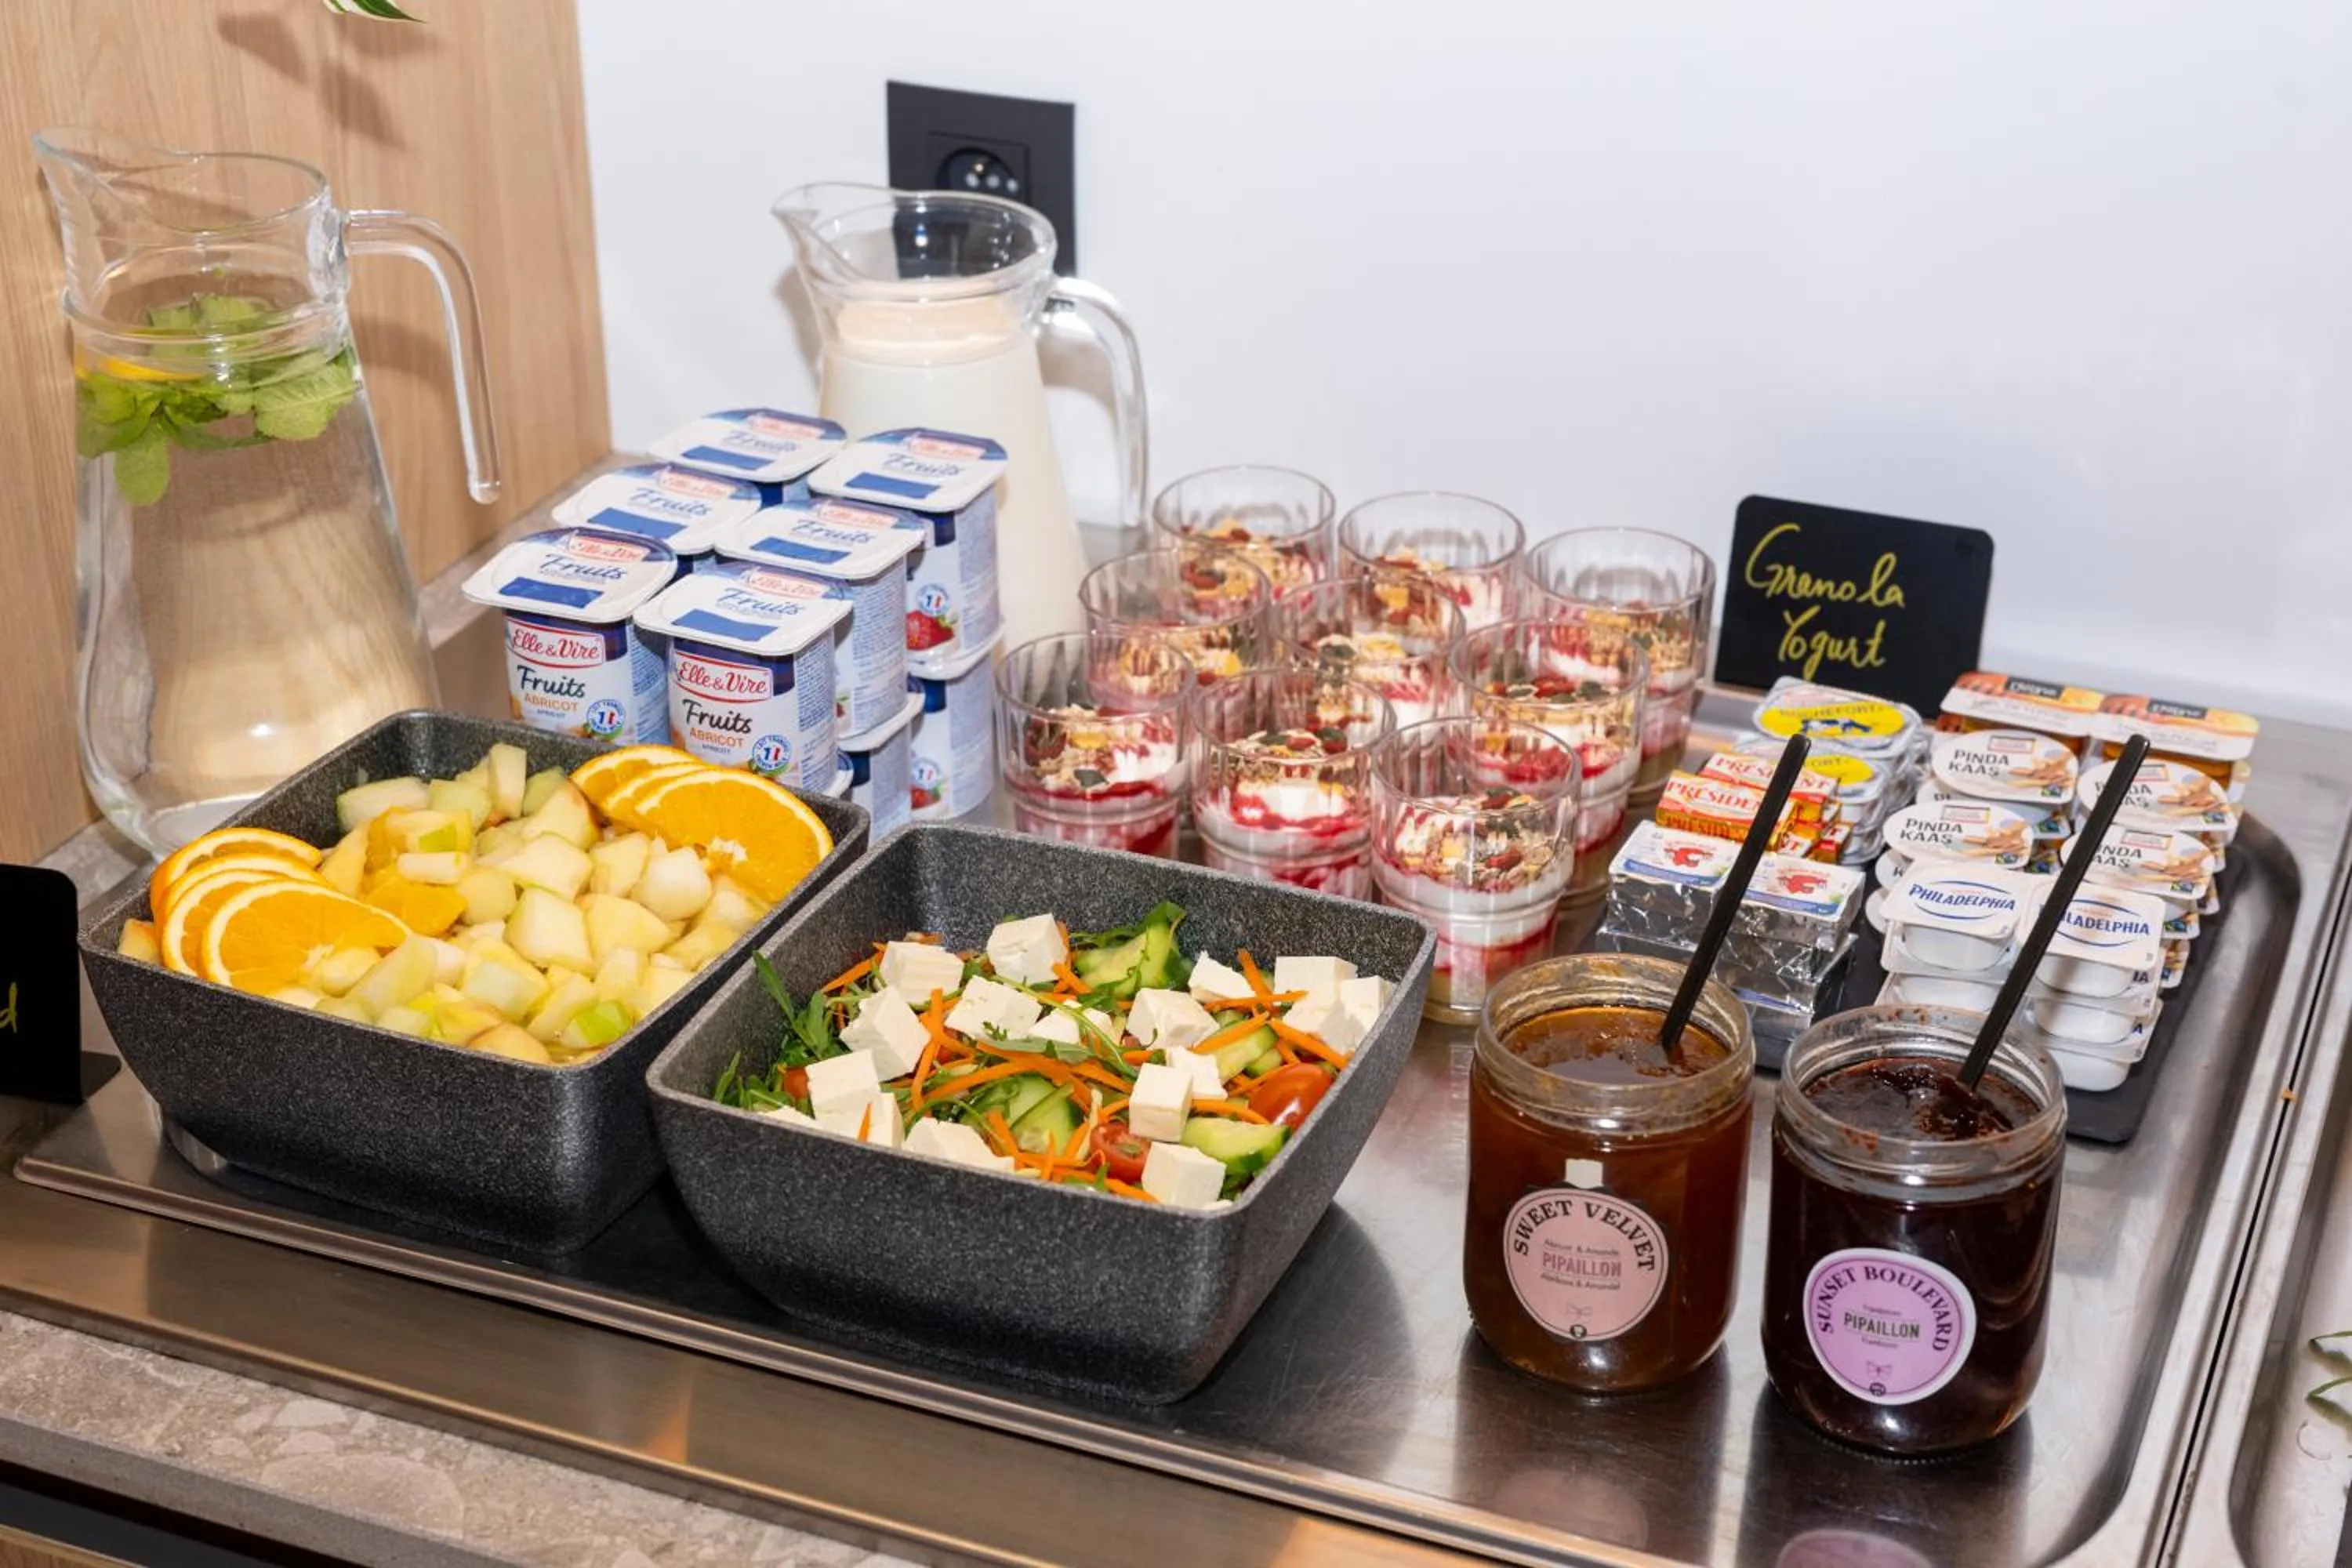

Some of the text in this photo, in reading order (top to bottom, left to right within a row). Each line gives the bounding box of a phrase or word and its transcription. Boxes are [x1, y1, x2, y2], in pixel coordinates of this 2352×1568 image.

[630, 488, 713, 515] Fruits
[792, 519, 876, 543] Fruits
[539, 553, 627, 579] Fruits
[717, 587, 805, 615] Fruits
[1778, 604, 1886, 682] Yogurt
[517, 665, 586, 699] Fruits
[524, 693, 579, 712] ABRICOT
[682, 699, 753, 734] Fruits
[690, 727, 744, 748] ABRICOT
[1948, 762, 2000, 777] KAAS
[1954, 749, 2009, 766] PINDA
[1900, 830, 1953, 844] KAAS
[1906, 818, 1964, 833] PINDA
[1908, 883, 2016, 912] PHILADELPHIA
[1514, 1200, 1656, 1272] SWEET VELVET
[1542, 1251, 1621, 1277] PIPAILLON
[1817, 1265, 1953, 1352] SUNSET BOULEVARD
[1844, 1312, 1920, 1338] PIPAILLON
